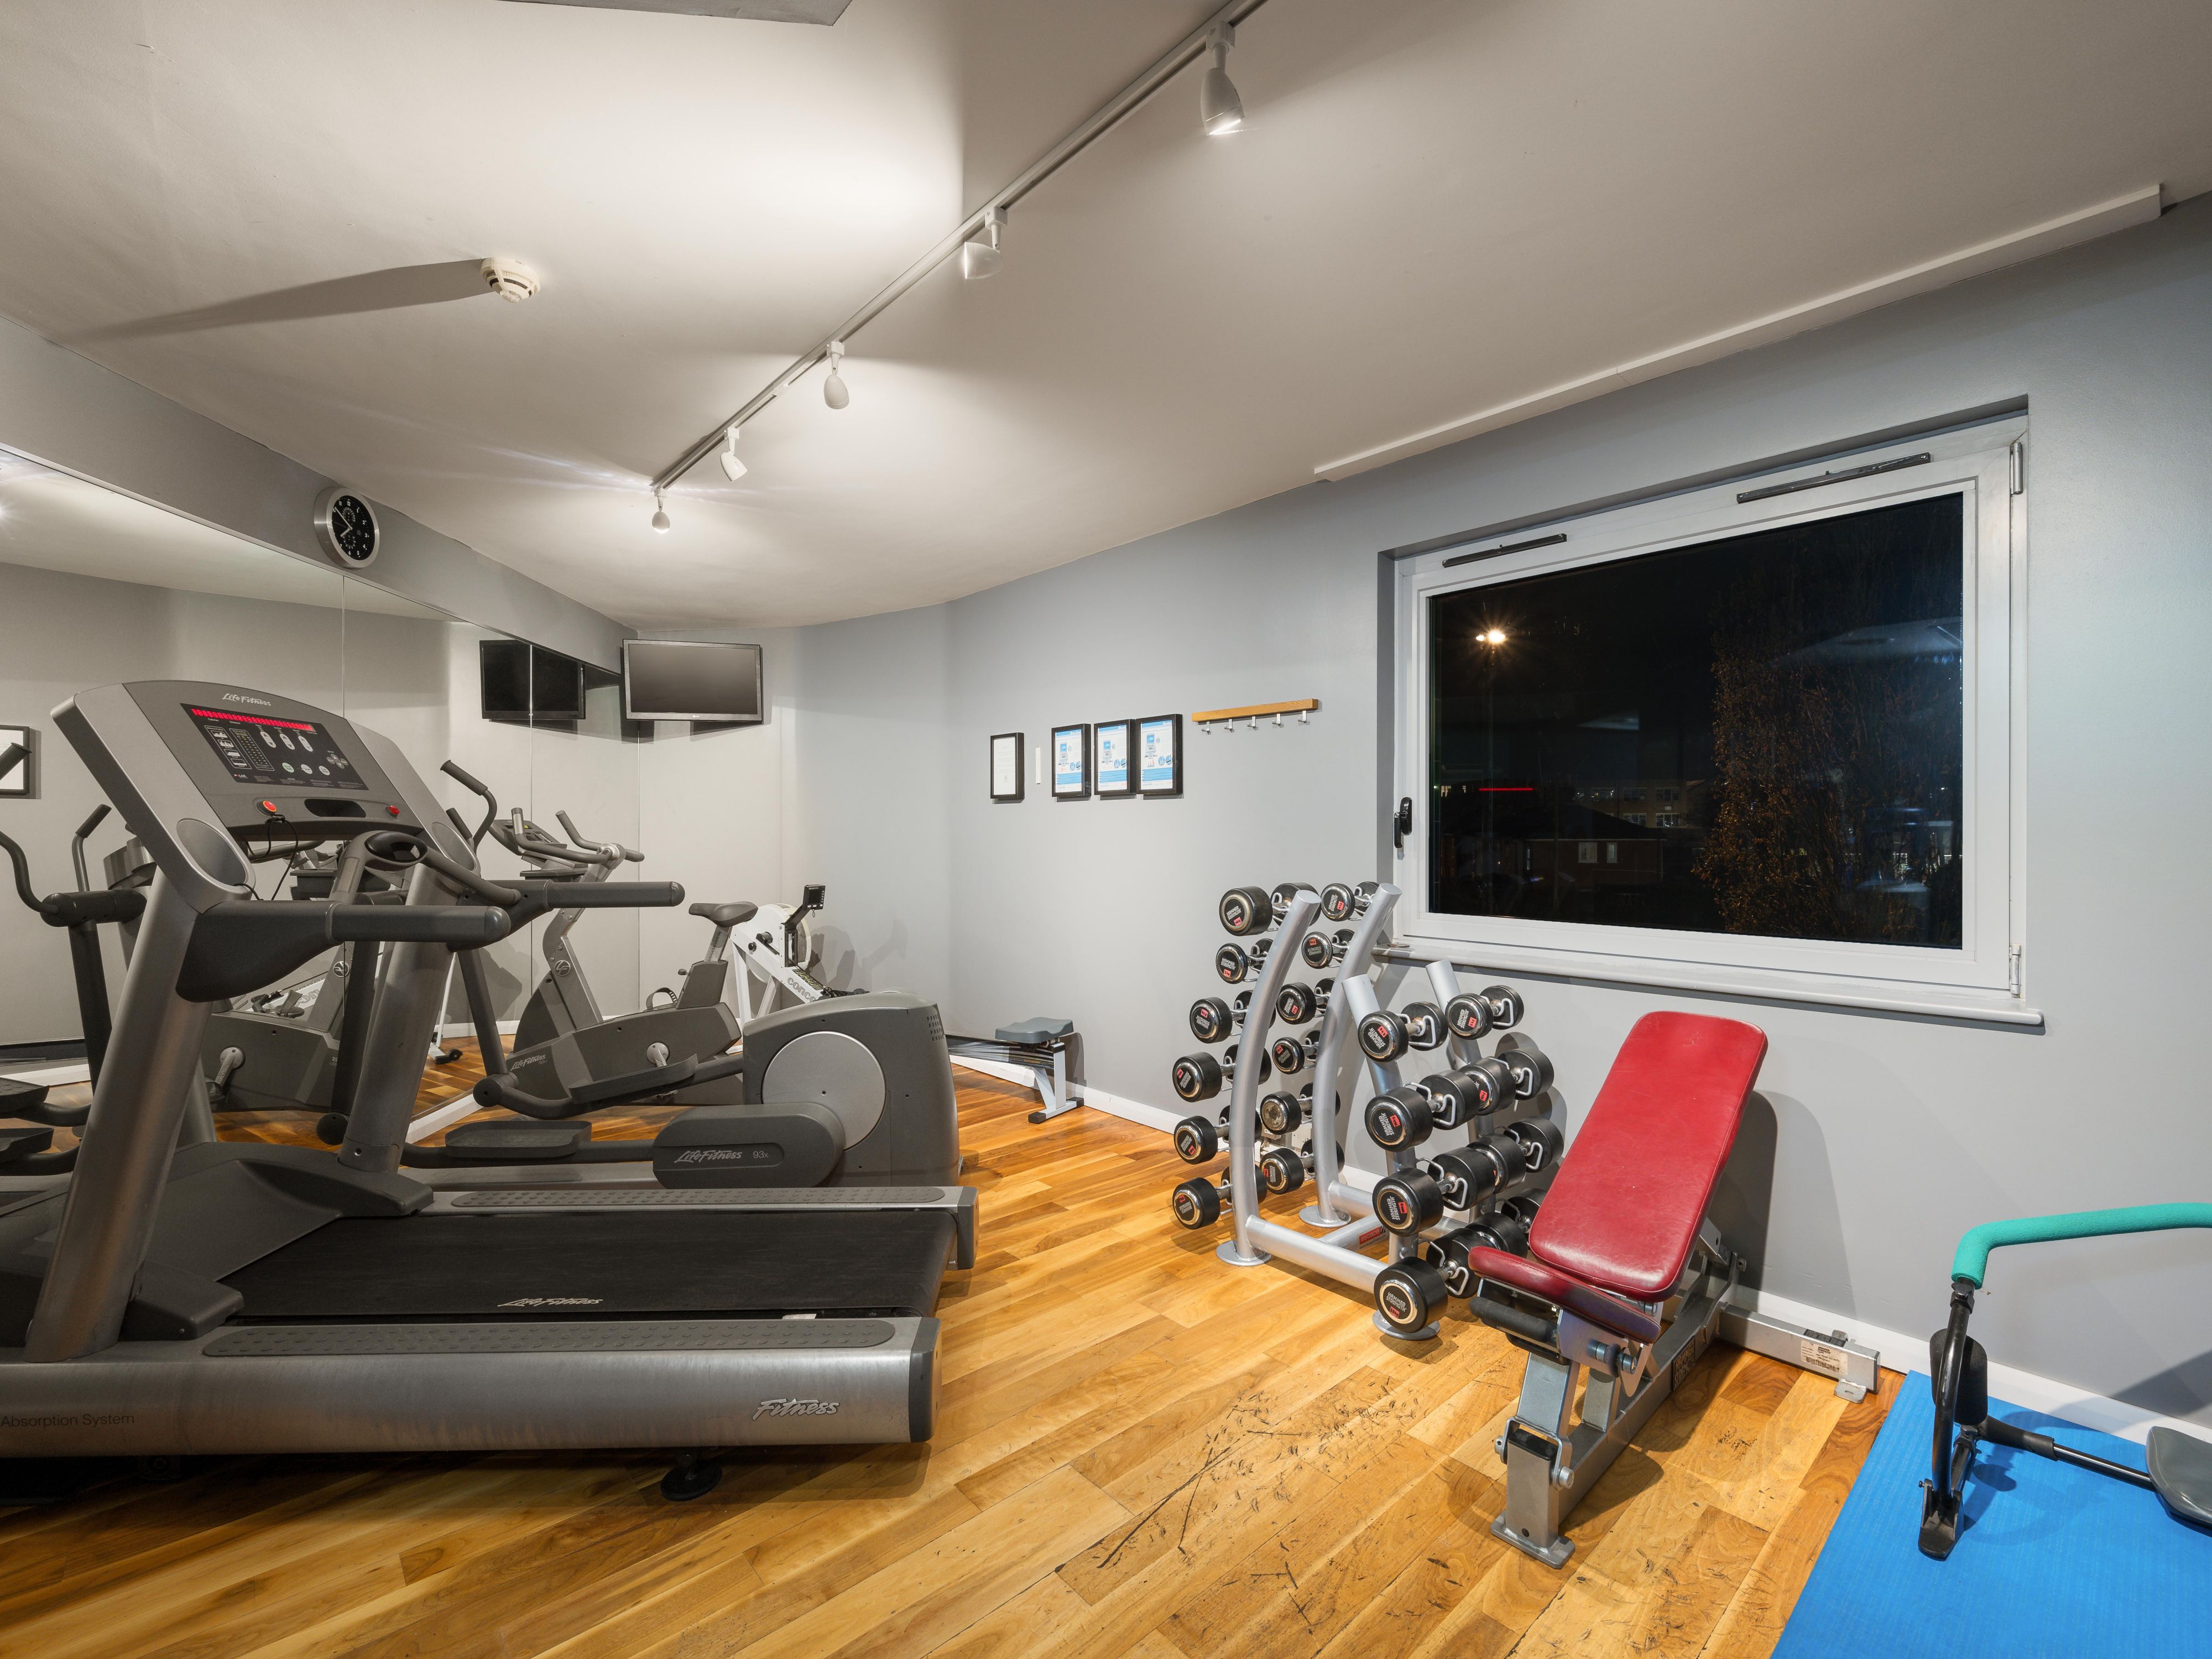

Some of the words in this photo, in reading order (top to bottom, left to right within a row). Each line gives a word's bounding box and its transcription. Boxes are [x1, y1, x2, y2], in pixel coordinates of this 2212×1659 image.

[1227, 906, 1239, 916] HAMMER
[787, 977, 816, 1002] conce
[1460, 1009, 1469, 1029] STRENGTH
[1368, 1032, 1383, 1049] HAMMER
[1370, 1028, 1385, 1047] STRENGTH
[1379, 1116, 1389, 1136] HAMMER
[1381, 1114, 1394, 1135] STRENGTH
[1387, 1198, 1395, 1220] HAMMER
[1390, 1197, 1400, 1220] STRENGTH
[1386, 1296, 1406, 1312] STRENGTH
[1387, 1292, 1406, 1306] HAMMER
[752, 1398, 839, 1421] Fitness
[1, 1416, 78, 1428] Absorption
[83, 1413, 134, 1427] System
